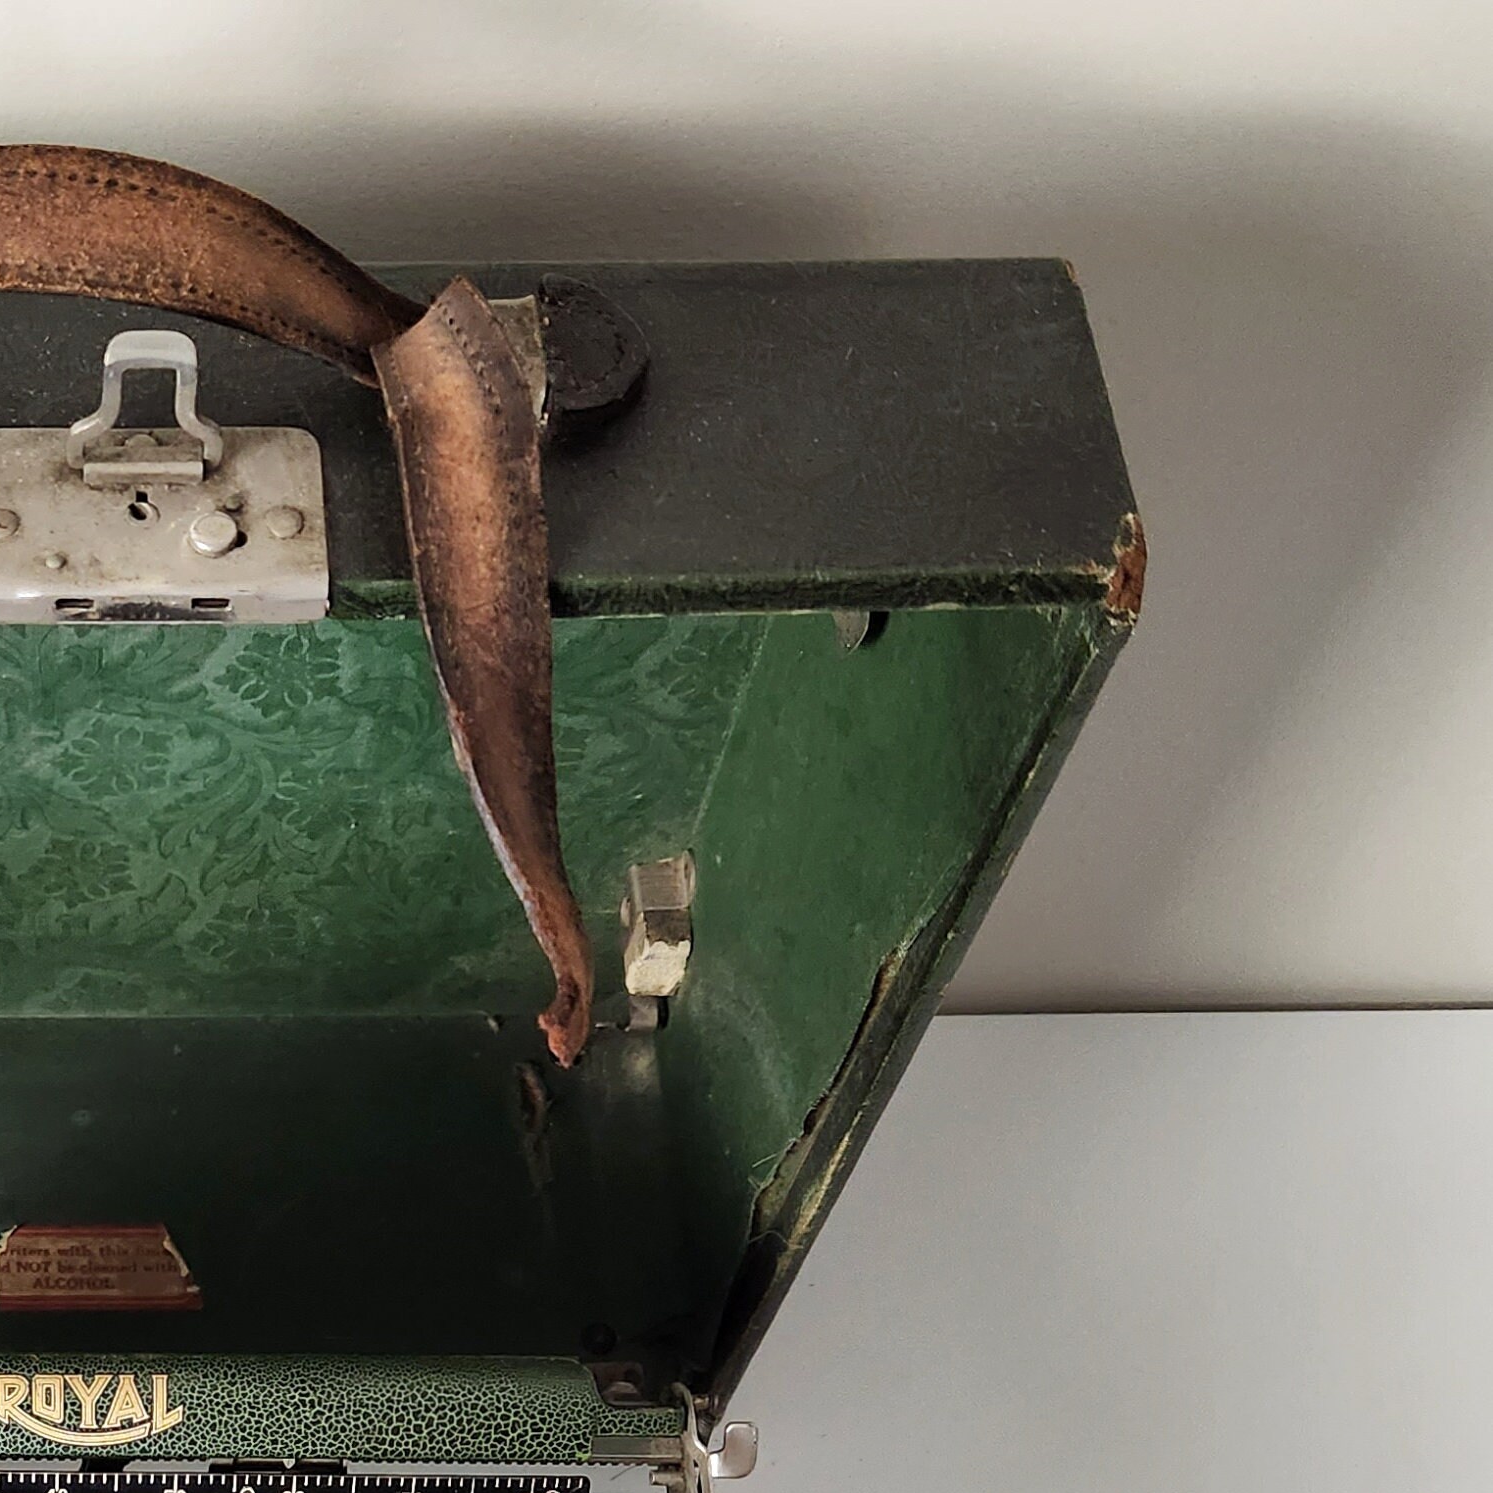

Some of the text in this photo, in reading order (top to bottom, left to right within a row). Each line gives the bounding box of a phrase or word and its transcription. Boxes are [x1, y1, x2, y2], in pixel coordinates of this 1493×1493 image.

[16, 1260, 52, 1273] NOT
[57, 1260, 76, 1274] be
[143, 1260, 178, 1273] with
